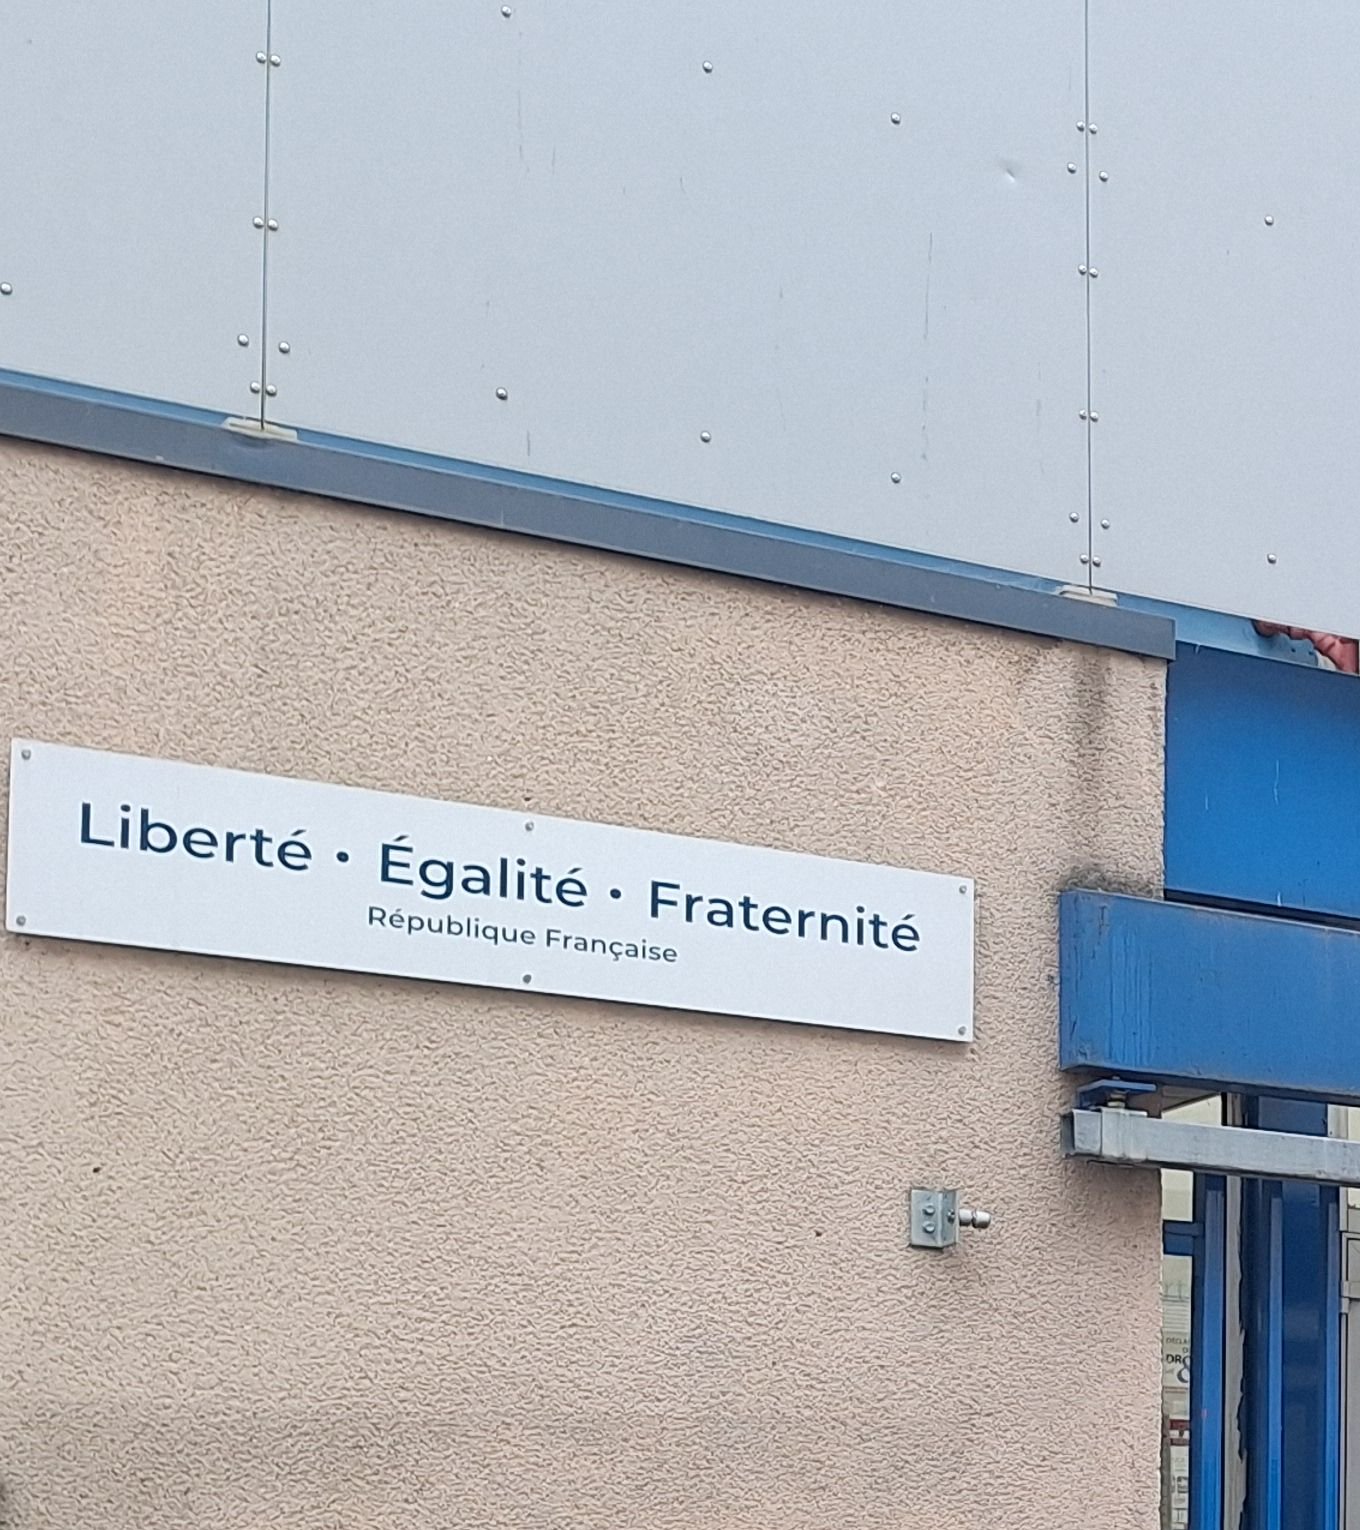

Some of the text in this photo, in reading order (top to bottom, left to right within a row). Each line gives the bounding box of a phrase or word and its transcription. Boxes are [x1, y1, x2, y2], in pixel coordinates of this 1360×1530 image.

[80, 801, 923, 952] Liberté Égalité Fraternité
[367, 906, 679, 963] République Française
